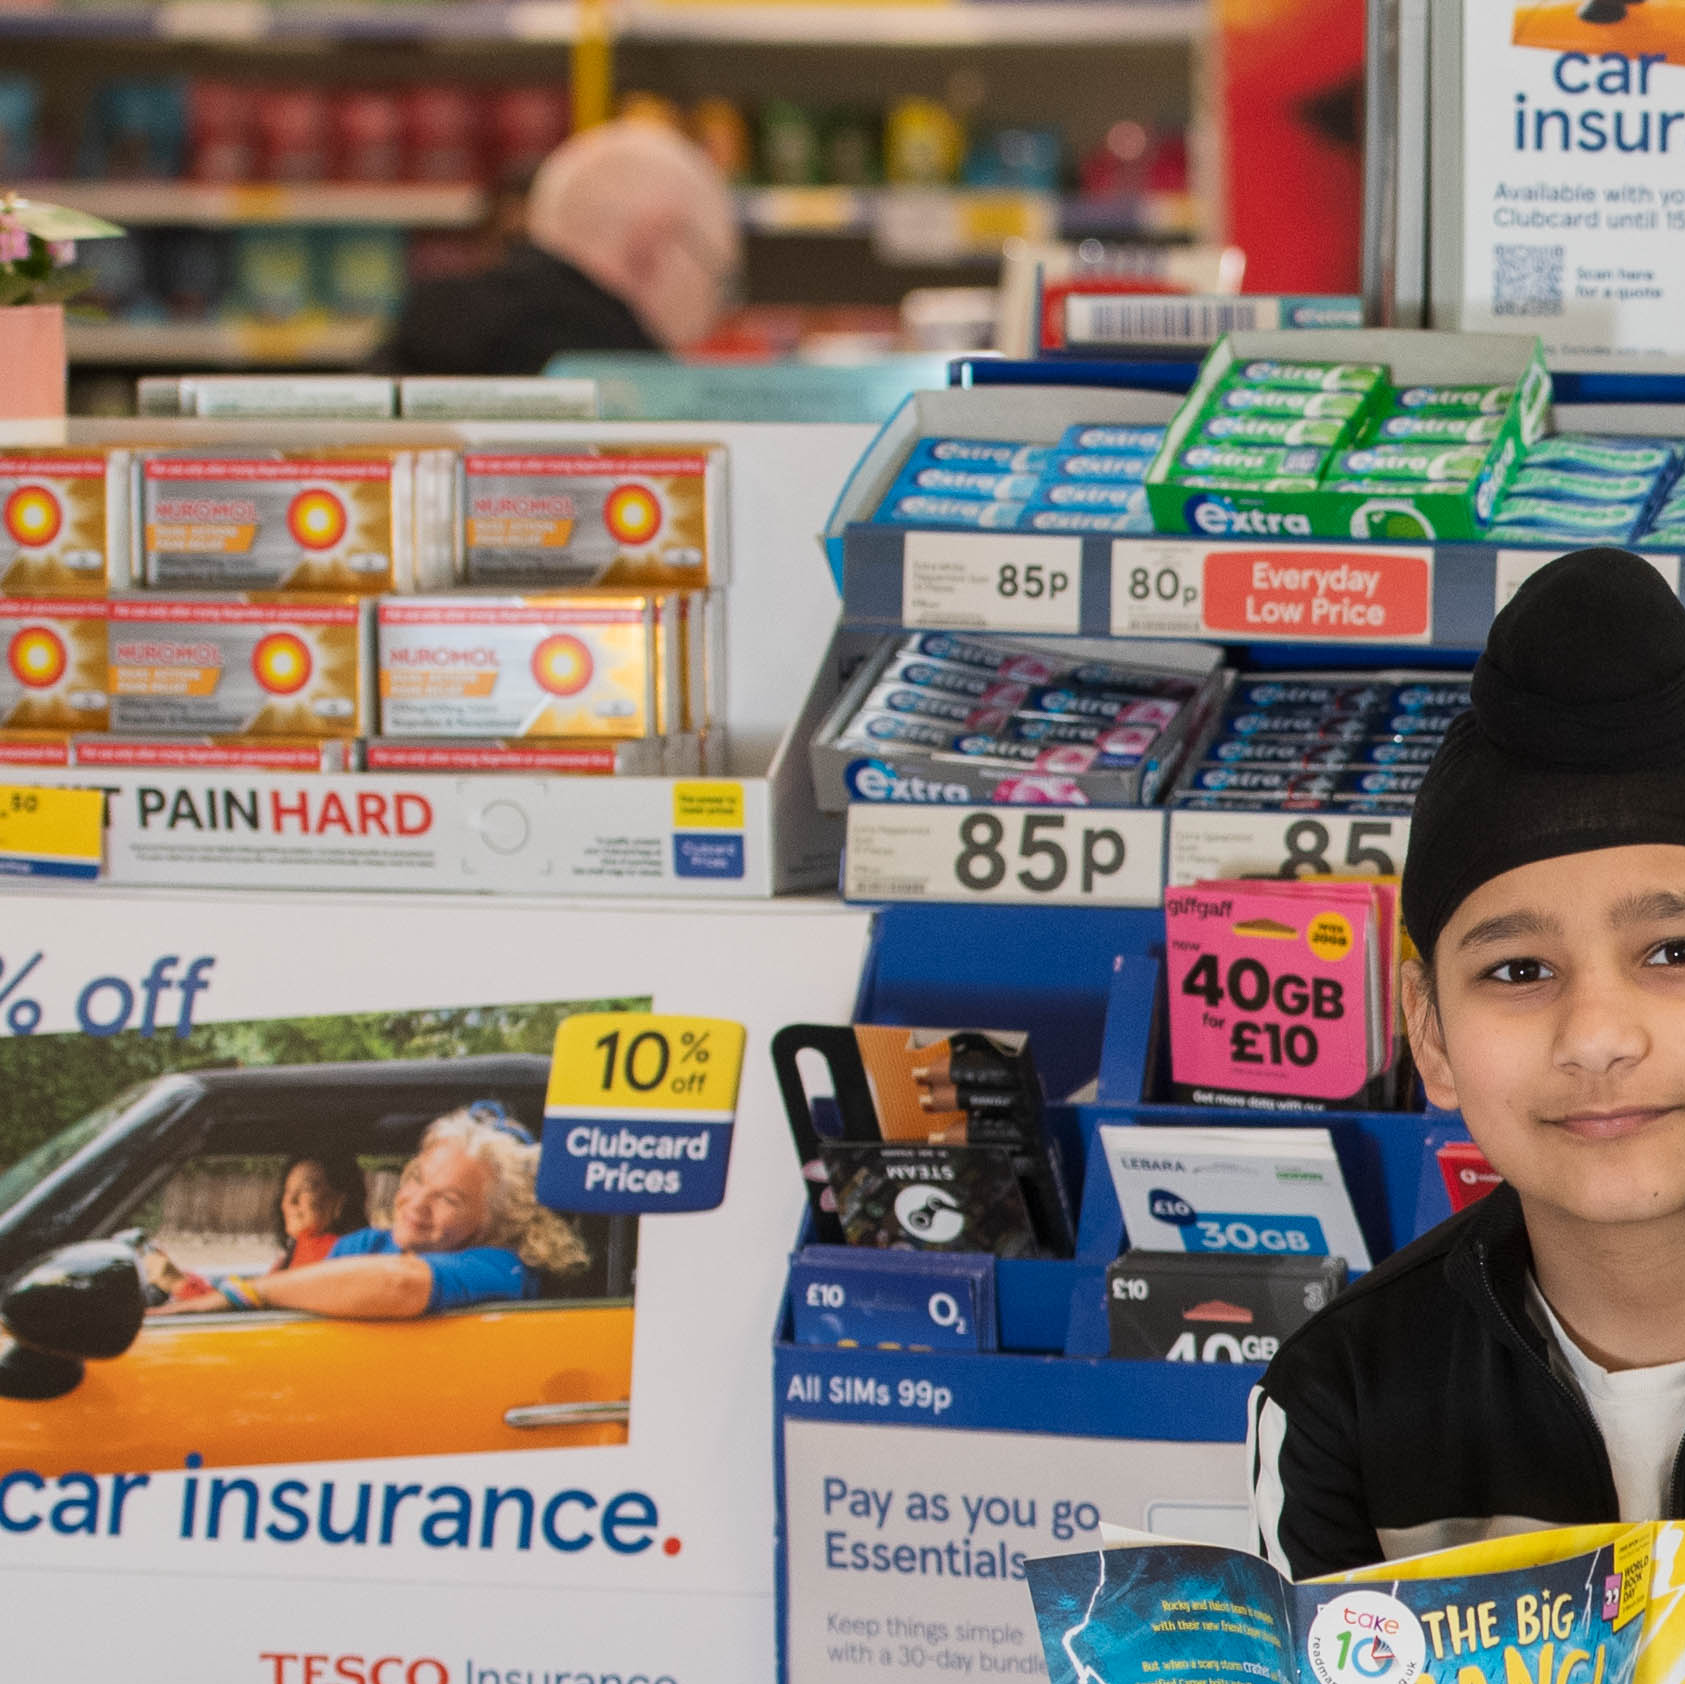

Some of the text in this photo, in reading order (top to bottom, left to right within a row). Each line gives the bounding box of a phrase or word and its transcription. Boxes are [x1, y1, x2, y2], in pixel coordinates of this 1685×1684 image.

[1553, 51, 1667, 96] car
[1493, 182, 1596, 203] Available
[1605, 183, 1653, 204] with
[1493, 209, 1598, 230] Clubcard
[1606, 210, 1657, 231] until
[1576, 266, 1655, 281] Scan here
[1575, 285, 1664, 301] for quote
[1244, 360, 1327, 382] extra
[1400, 387, 1481, 409] extra
[1078, 426, 1158, 449] extra
[1205, 417, 1289, 438] extra
[933, 441, 1014, 463] extra
[1345, 450, 1428, 472] extra
[1194, 498, 1312, 536] extra
[996, 564, 1070, 600] 85p
[1128, 568, 1199, 605] 80p
[1252, 561, 1381, 598] Everyday
[1245, 596, 1387, 627] Low Price
[136, 786, 261, 831] PAIN
[270, 788, 434, 838] HARD
[953, 811, 1126, 893] 85p
[1166, 897, 1233, 919] giffgaff
[75, 955, 217, 1040] off
[1181, 953, 1345, 1022] 40GB
[1202, 1012, 1319, 1067] for £10
[594, 1029, 672, 1093] 10
[671, 1069, 708, 1096] off
[566, 1126, 709, 1162] Clubcard
[584, 1161, 681, 1195] Prices
[886, 1164, 955, 1180] STEAM
[1120, 1156, 1187, 1174] LEBARA
[1196, 1221, 1311, 1251] 30GB
[806, 1282, 845, 1309] £10
[1111, 1277, 1149, 1301] £10
[788, 1374, 953, 1415] All SIMs 99p
[0, 1452, 682, 1556] car insurance.
[822, 1476, 1101, 1541] Pay as you go
[825, 1530, 1027, 1581] Essentials
[827, 1612, 1024, 1648] Keep things simple
[1343, 1607, 1400, 1635] take
[1420, 1600, 1501, 1660] THE
[826, 1639, 974, 1675] with 30-day
